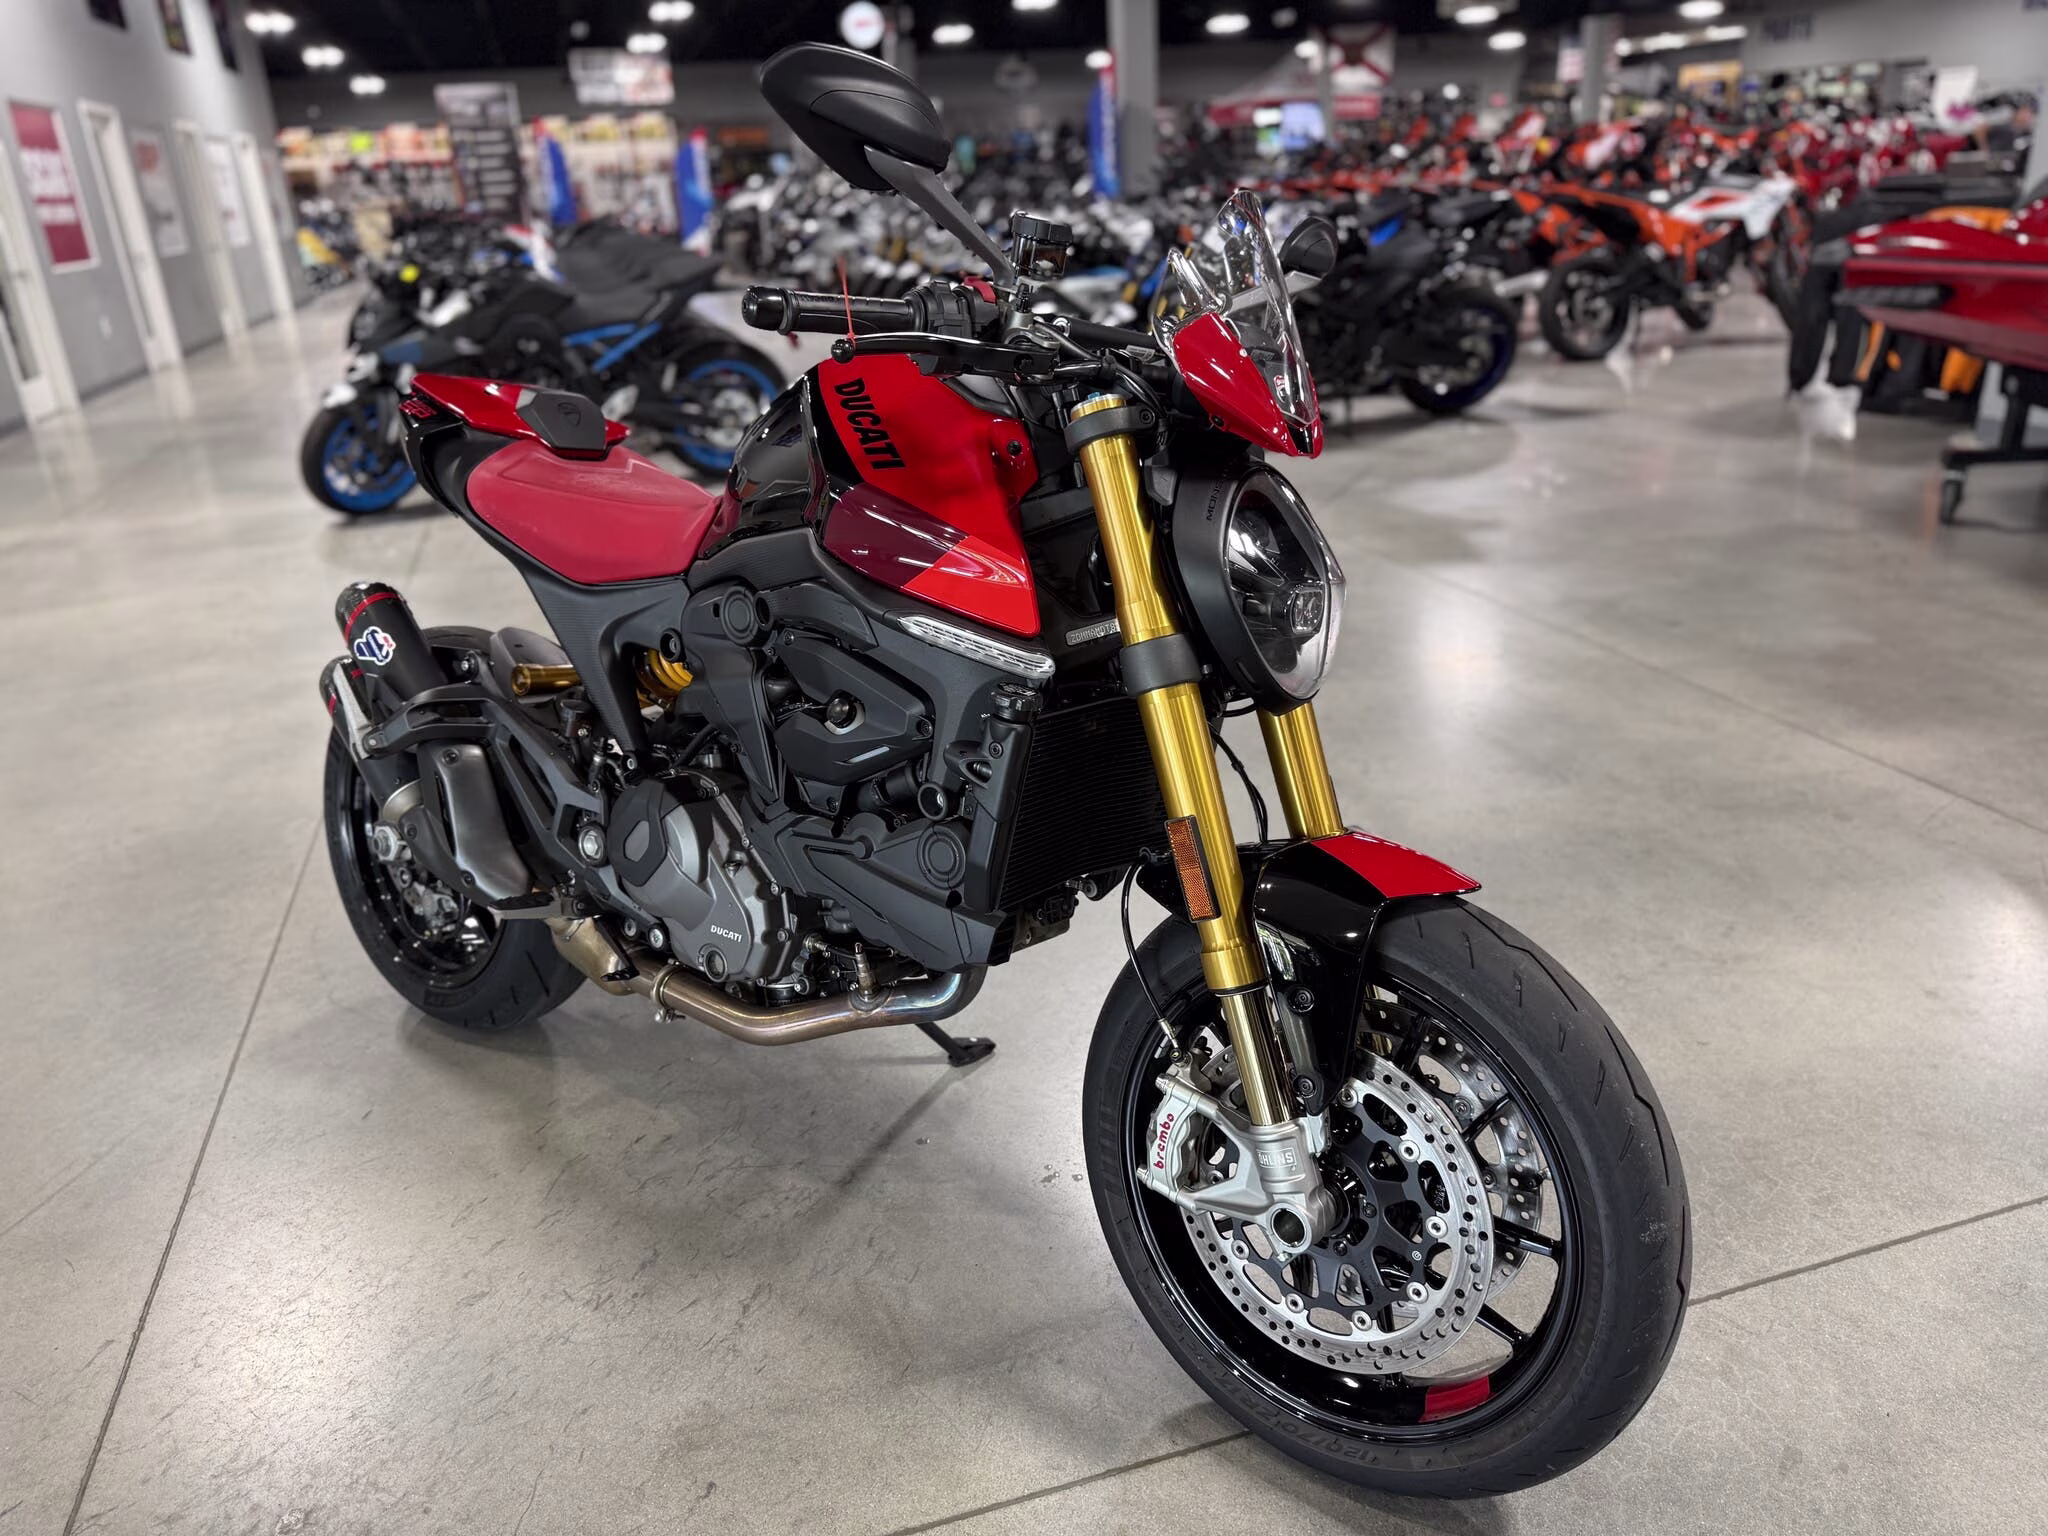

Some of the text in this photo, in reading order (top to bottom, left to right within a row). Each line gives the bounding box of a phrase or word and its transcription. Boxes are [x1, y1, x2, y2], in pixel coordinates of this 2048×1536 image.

[834, 377, 906, 470] DUCATI
[710, 924, 743, 943] DUCATI
[1153, 1113, 1174, 1169] brembo
